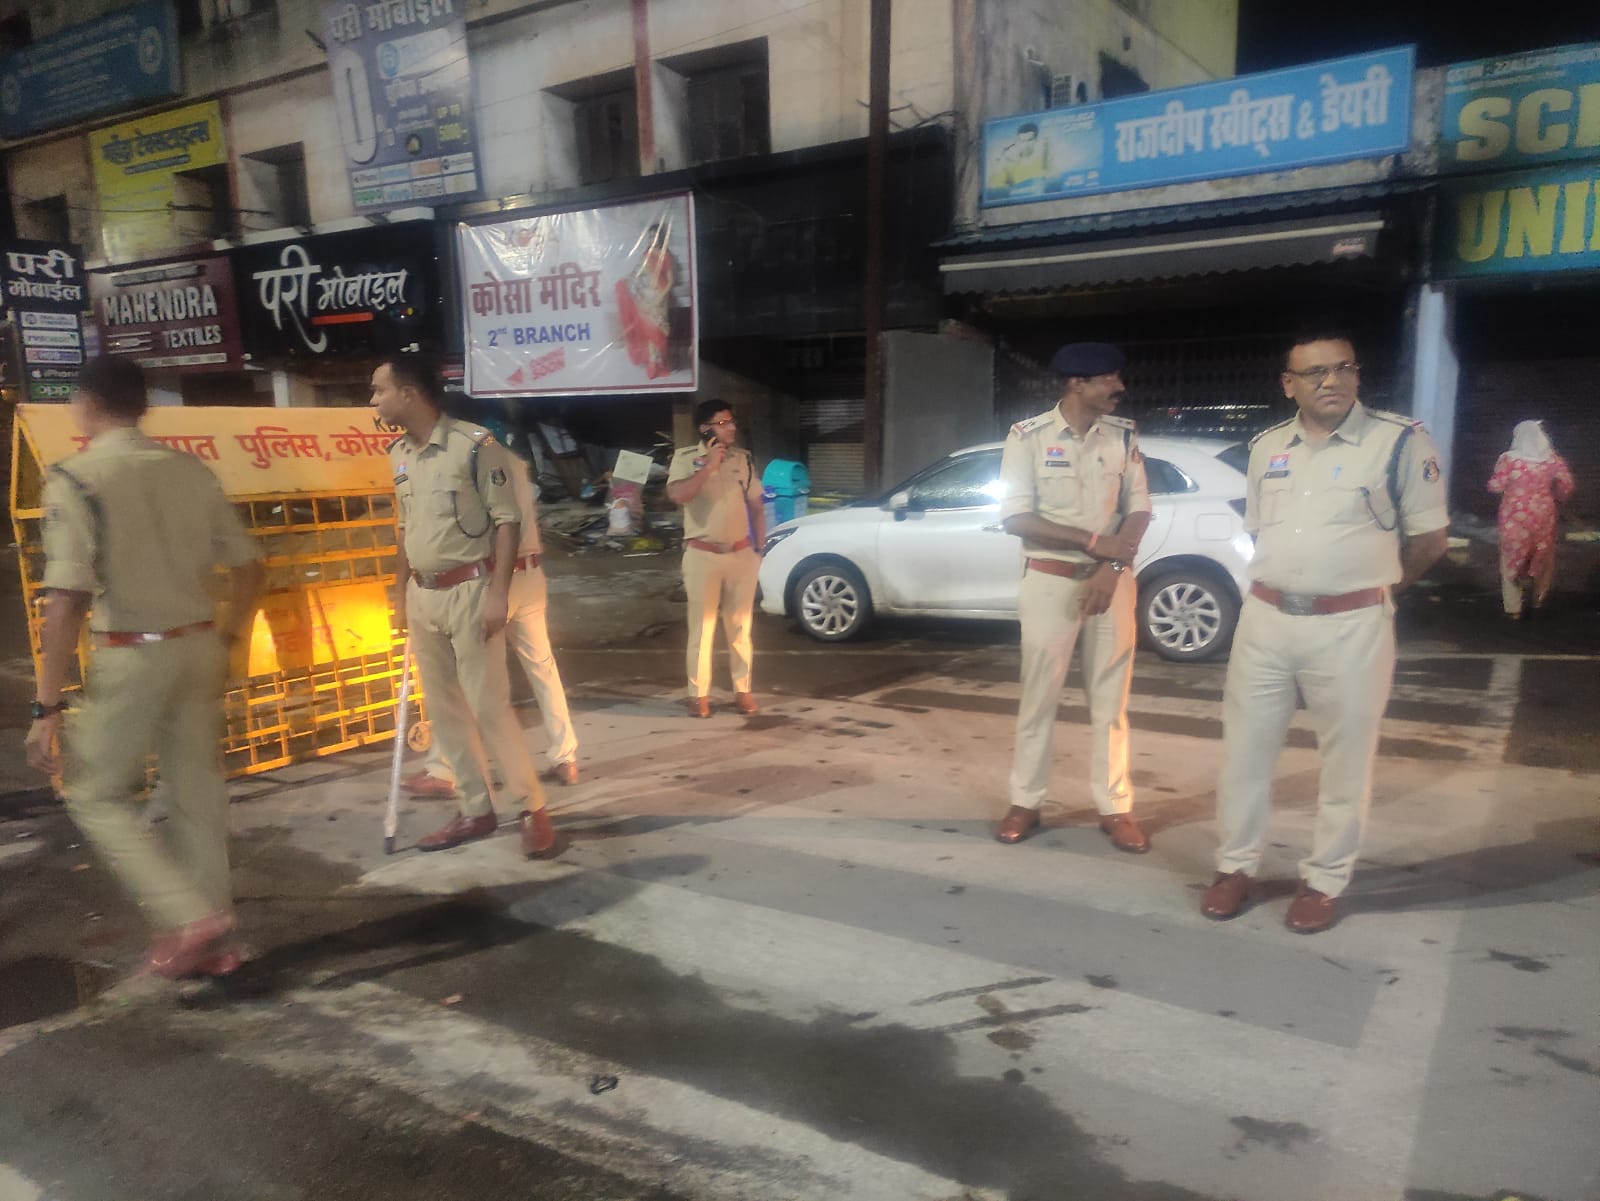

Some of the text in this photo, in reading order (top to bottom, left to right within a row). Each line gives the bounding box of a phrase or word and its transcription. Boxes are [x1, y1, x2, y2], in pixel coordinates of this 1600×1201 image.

[1115, 101, 1203, 164] राजदीप
[1296, 102, 1315, 140] &
[1320, 64, 1392, 133] डेयरी
[1457, 179, 1600, 262] UNI
[6, 249, 76, 278] परी
[102, 284, 218, 326] MAHENDRA
[252, 244, 328, 353] परी
[471, 262, 602, 317] कोसा मंदिर
[162, 325, 222, 349] TEXTILES
[513, 322, 591, 345] BRANCH
